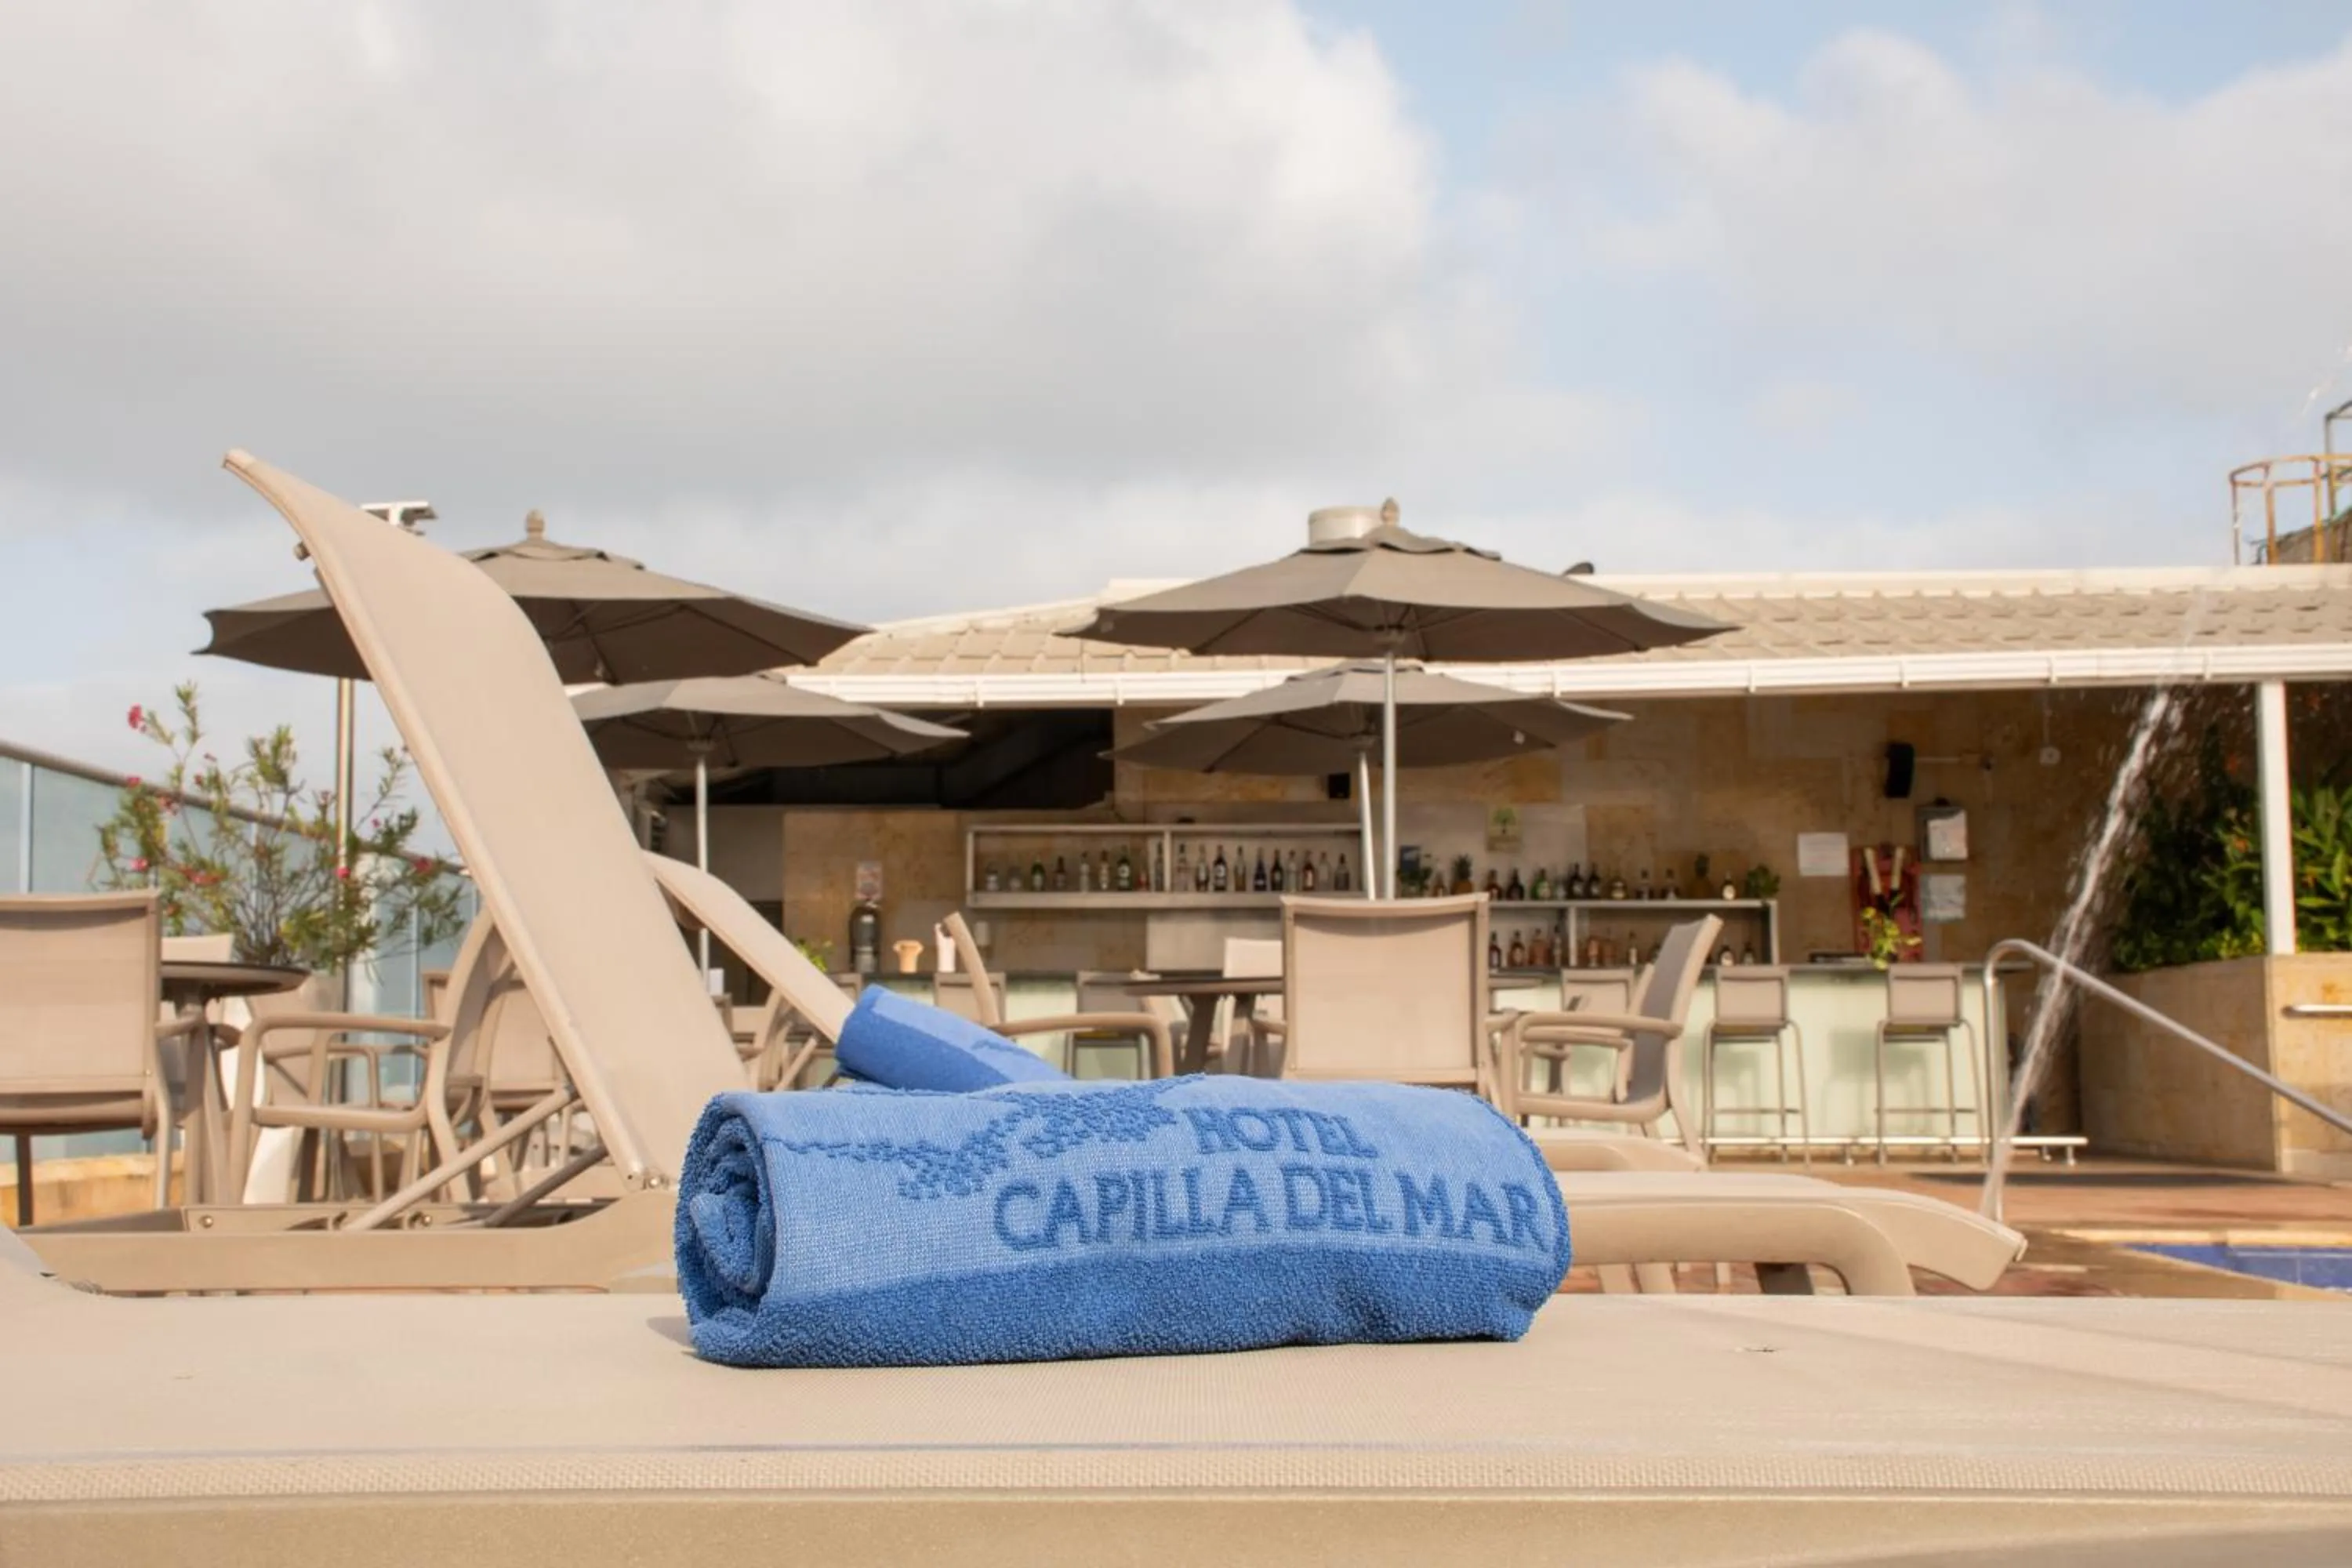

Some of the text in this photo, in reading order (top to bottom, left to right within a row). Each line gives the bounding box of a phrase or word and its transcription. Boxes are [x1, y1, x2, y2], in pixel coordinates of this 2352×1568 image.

[1181, 1106, 1378, 1158] HOTEL
[993, 1163, 1550, 1253] CAPILLA DEL MAR
